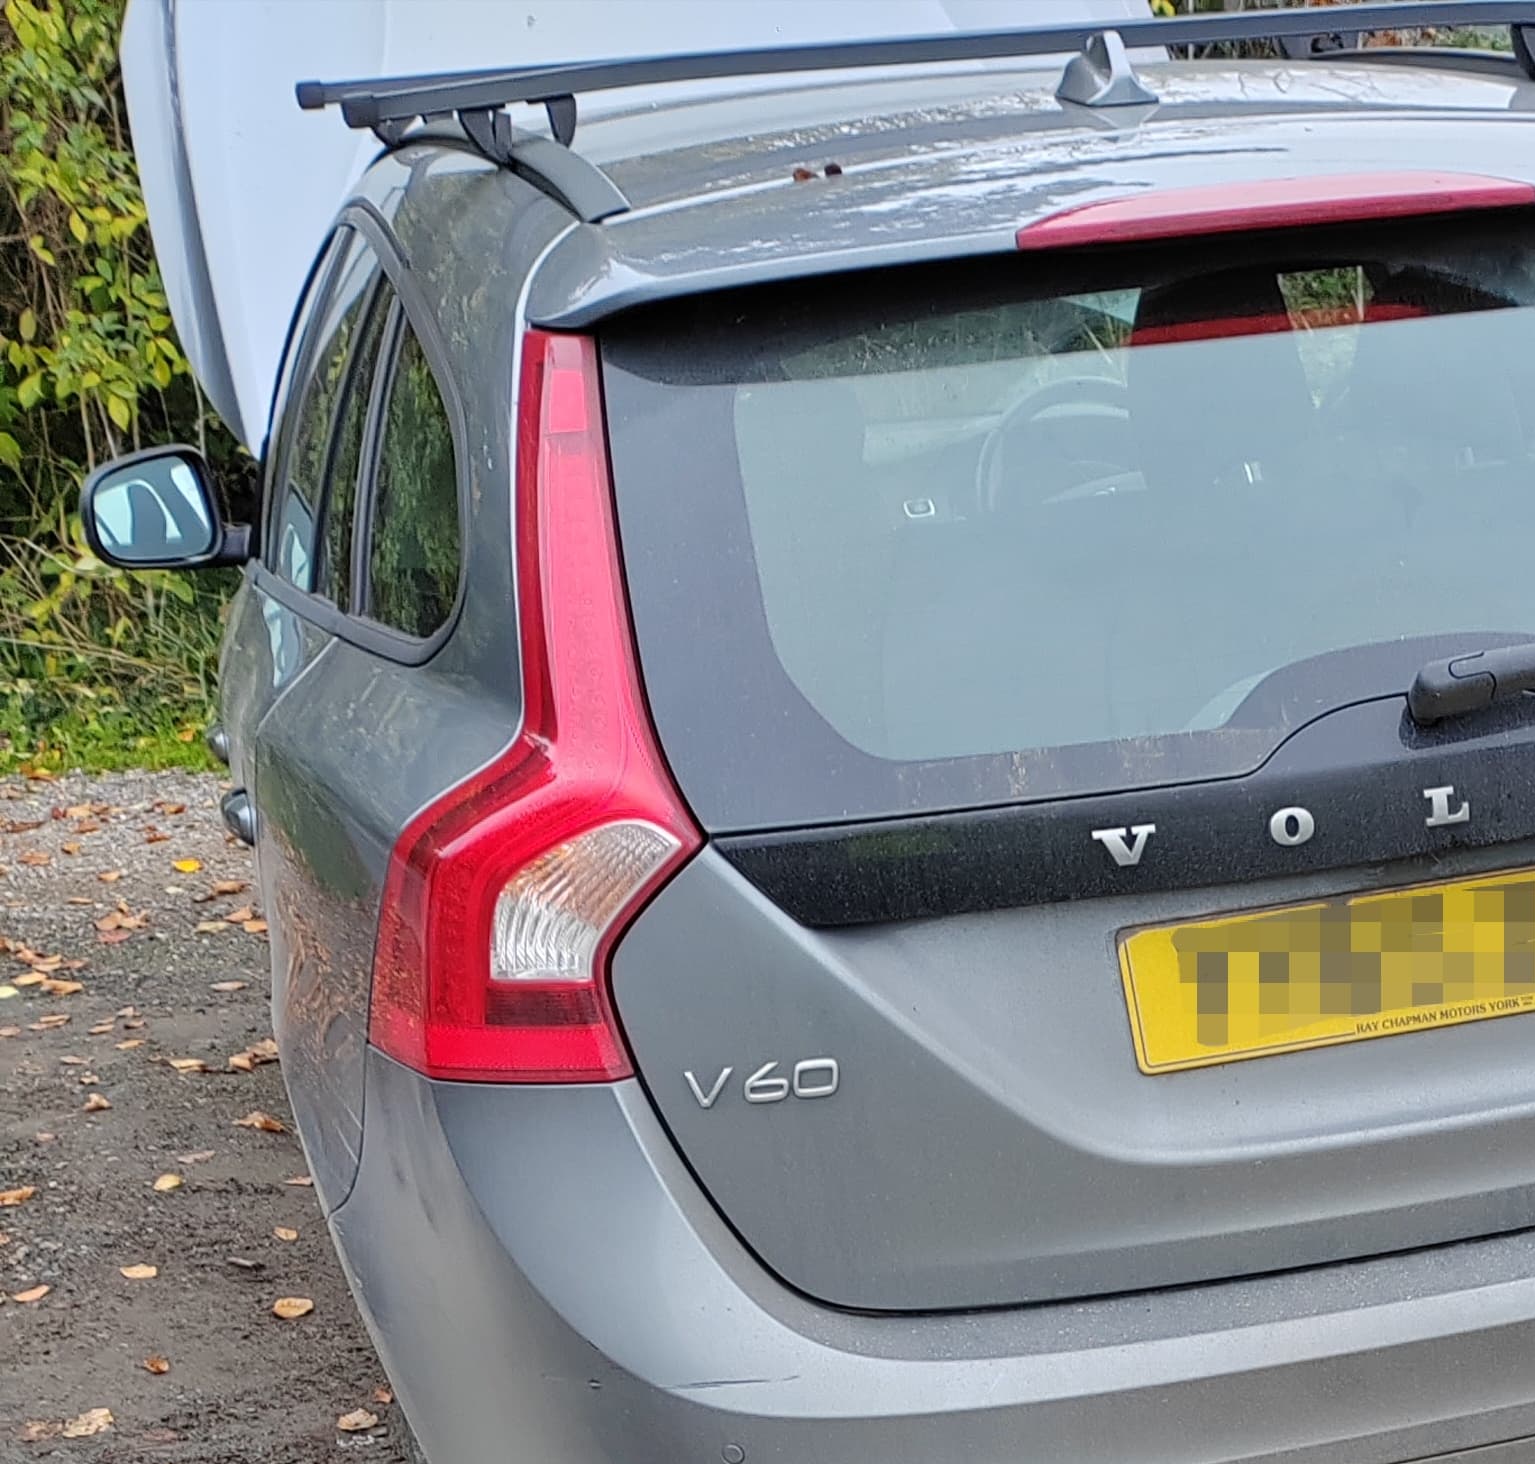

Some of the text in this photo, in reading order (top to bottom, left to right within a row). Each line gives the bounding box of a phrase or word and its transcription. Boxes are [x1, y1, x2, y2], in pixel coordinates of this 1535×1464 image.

[1356, 1021, 1379, 1033] RAY
[1382, 1011, 1437, 1030] CHAPMAN
[1440, 1003, 1487, 1020] MOTORS
[1488, 998, 1520, 1012] YORK
[683, 1058, 839, 1109] V60
